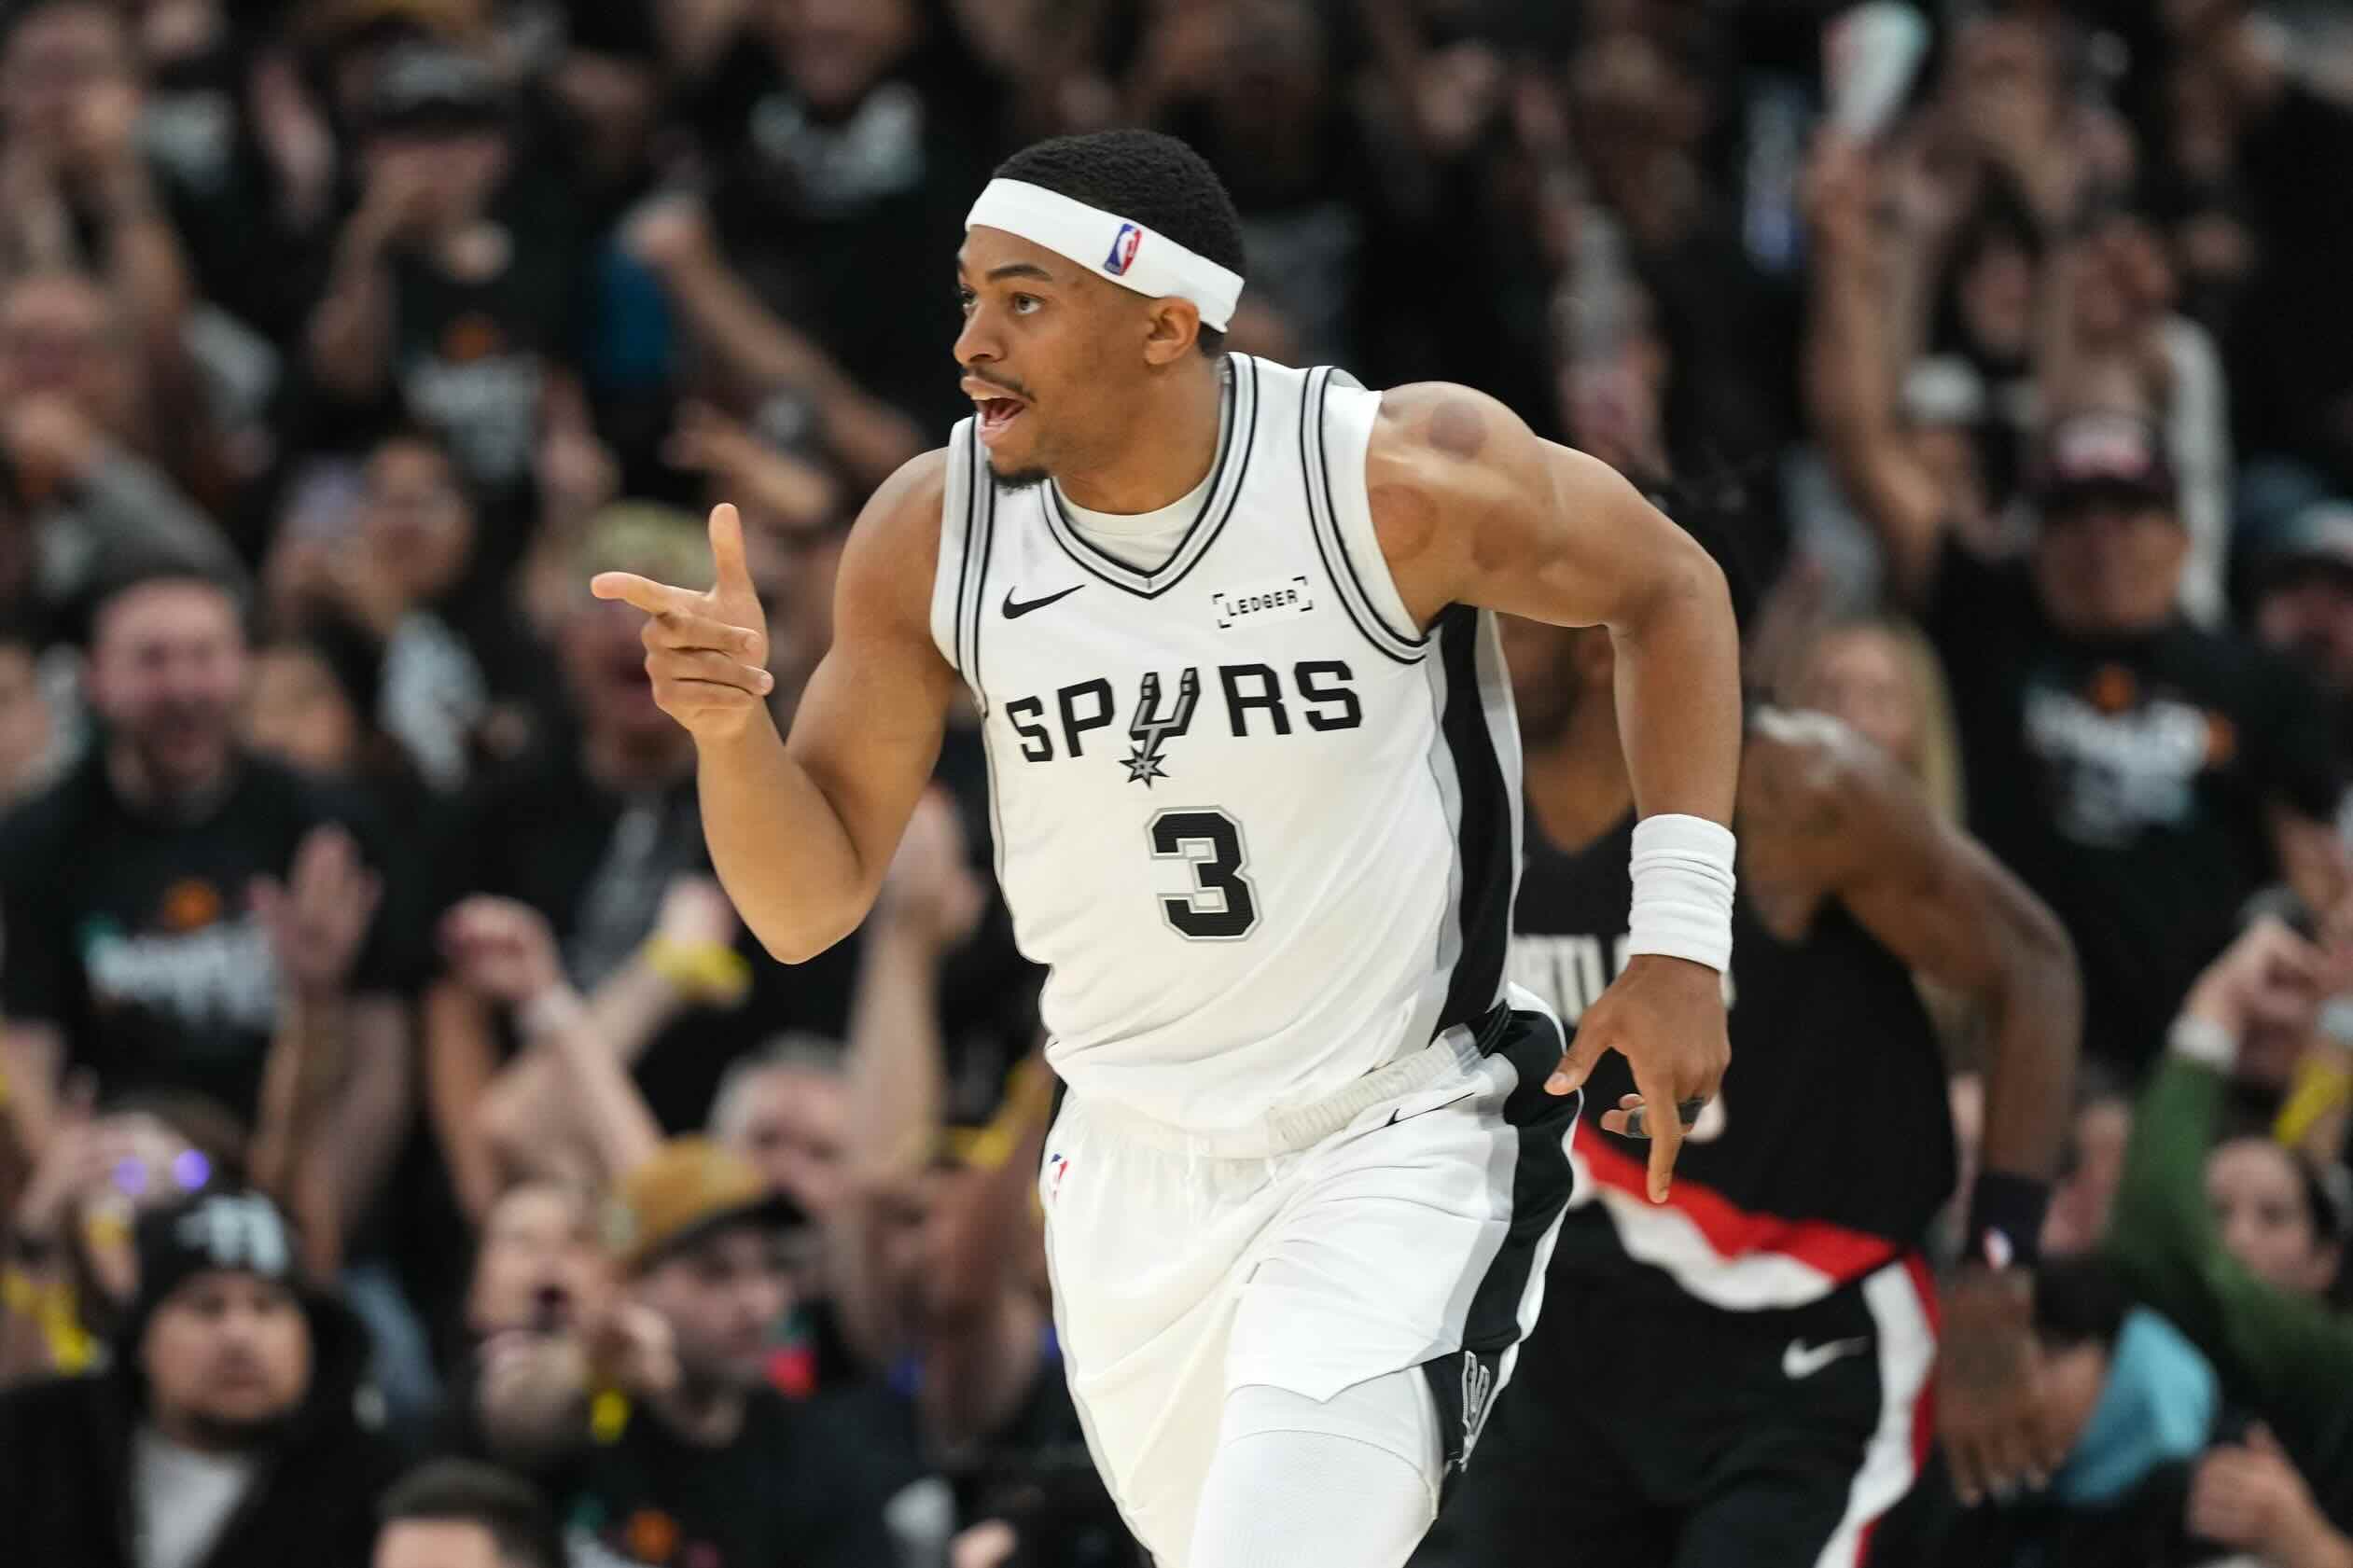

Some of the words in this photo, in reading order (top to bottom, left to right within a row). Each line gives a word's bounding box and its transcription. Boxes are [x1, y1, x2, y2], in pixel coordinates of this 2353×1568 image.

[1226, 589, 1299, 617] LEDGER
[1005, 659, 1363, 788] SPURS
[1146, 806, 1261, 942] 3
